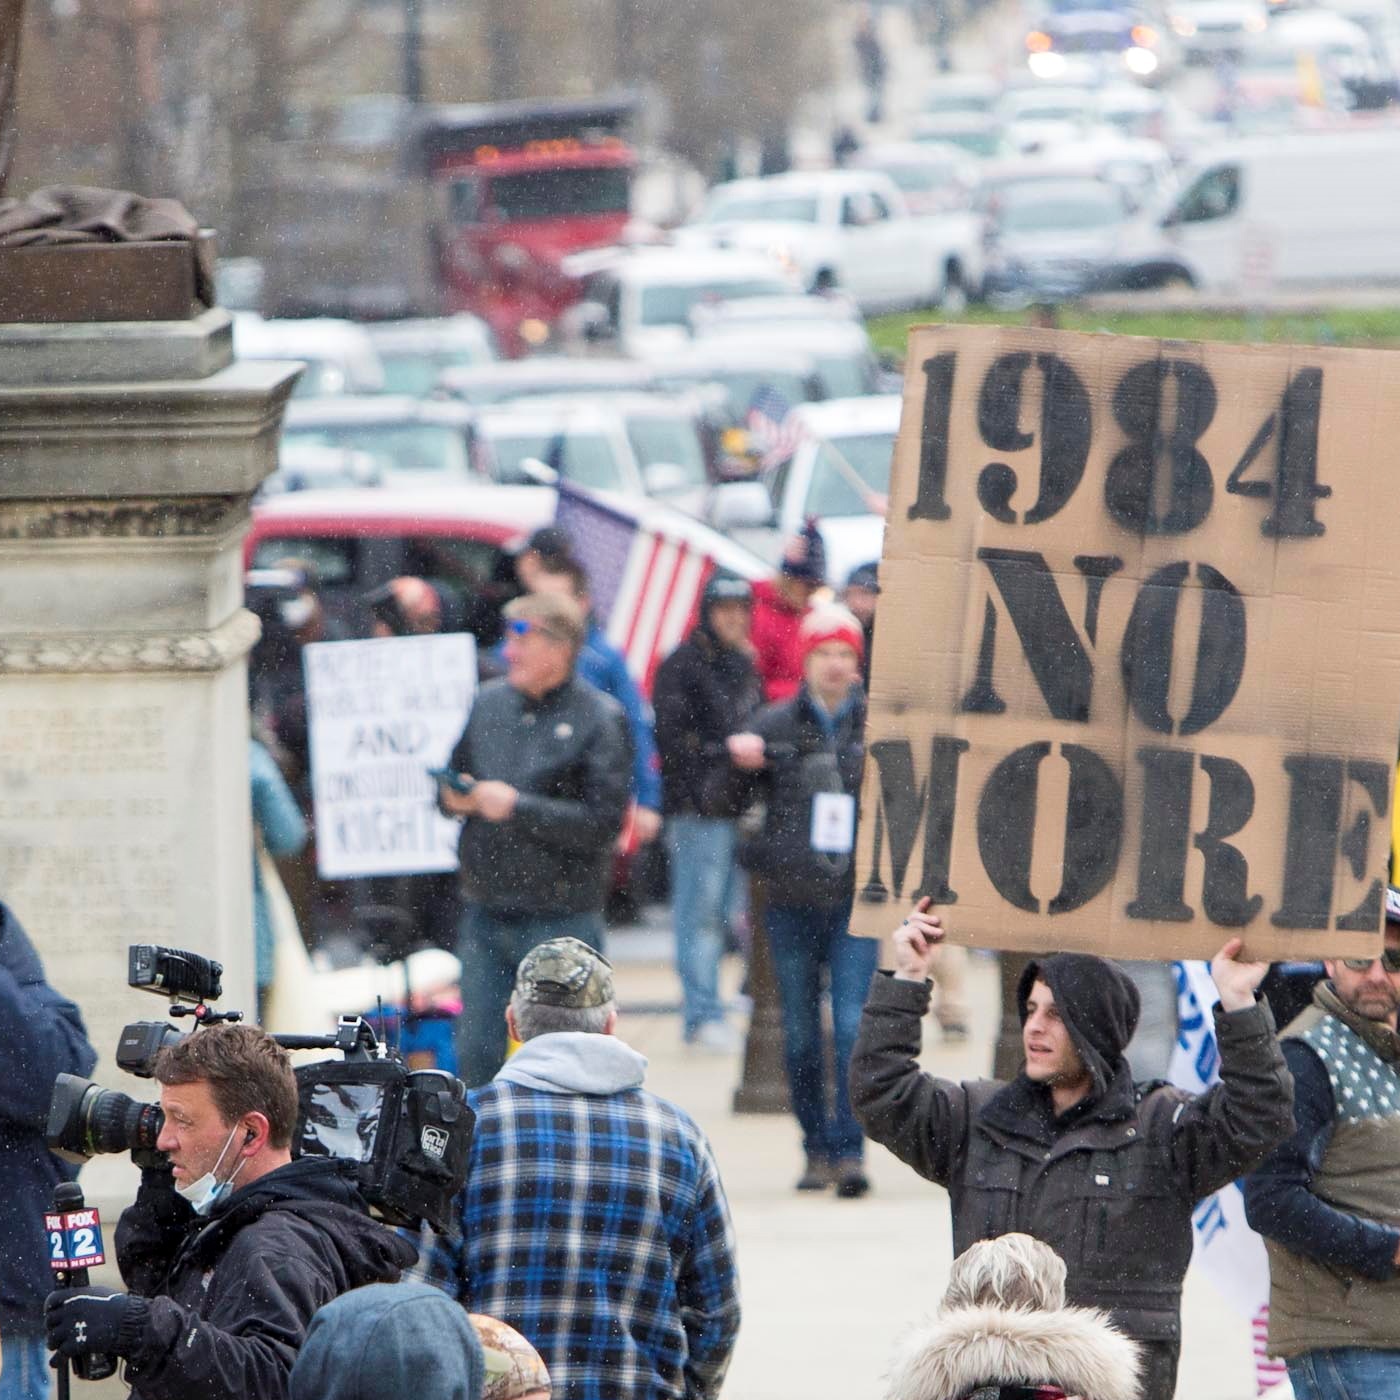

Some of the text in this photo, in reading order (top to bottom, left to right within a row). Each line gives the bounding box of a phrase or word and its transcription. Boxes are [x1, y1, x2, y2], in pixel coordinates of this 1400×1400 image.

[907, 351, 1332, 538] 1984
[961, 547, 1247, 737] NO
[860, 737, 1390, 932] MORE
[67, 1211, 96, 1228] FOX
[50, 1231, 65, 1259] 2
[73, 1228, 97, 1257] 2
[70, 1256, 103, 1268] NEWS
